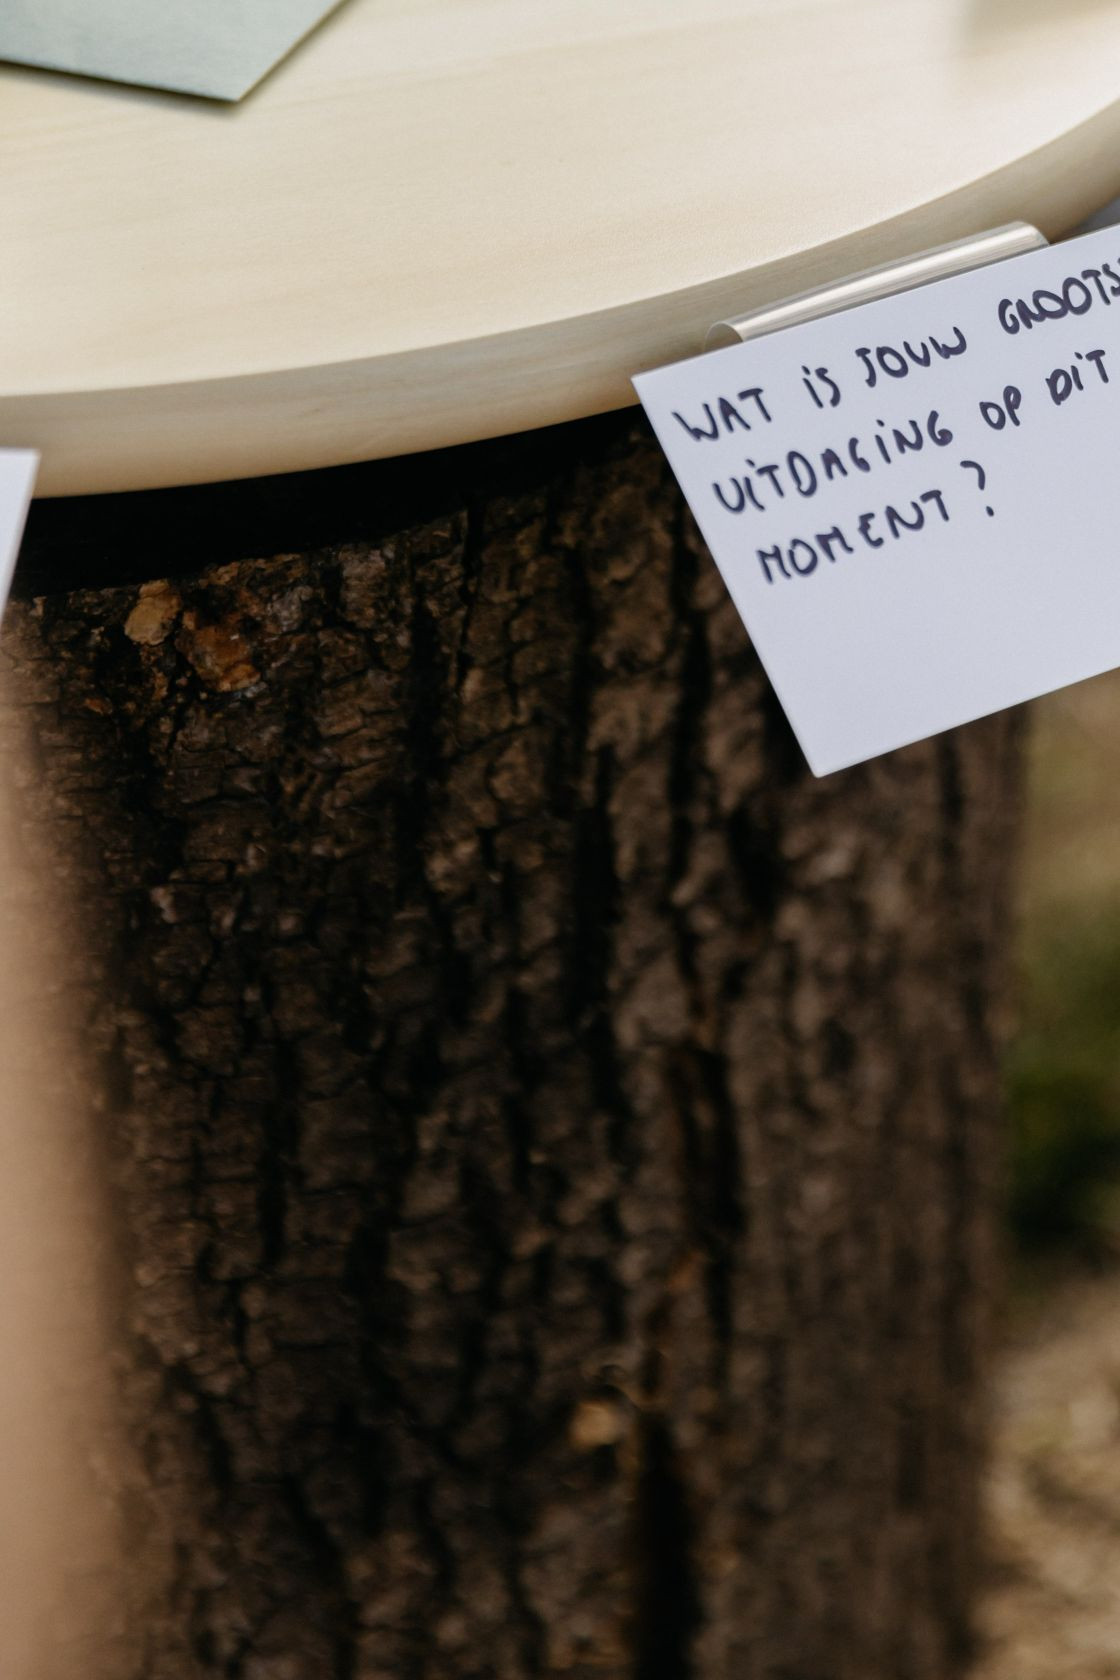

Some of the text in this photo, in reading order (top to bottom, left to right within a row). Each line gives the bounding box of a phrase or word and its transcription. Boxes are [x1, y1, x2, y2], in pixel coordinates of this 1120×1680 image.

[671, 386, 773, 443] WAT
[854, 326, 968, 389] JOUW
[978, 384, 1022, 431] OP
